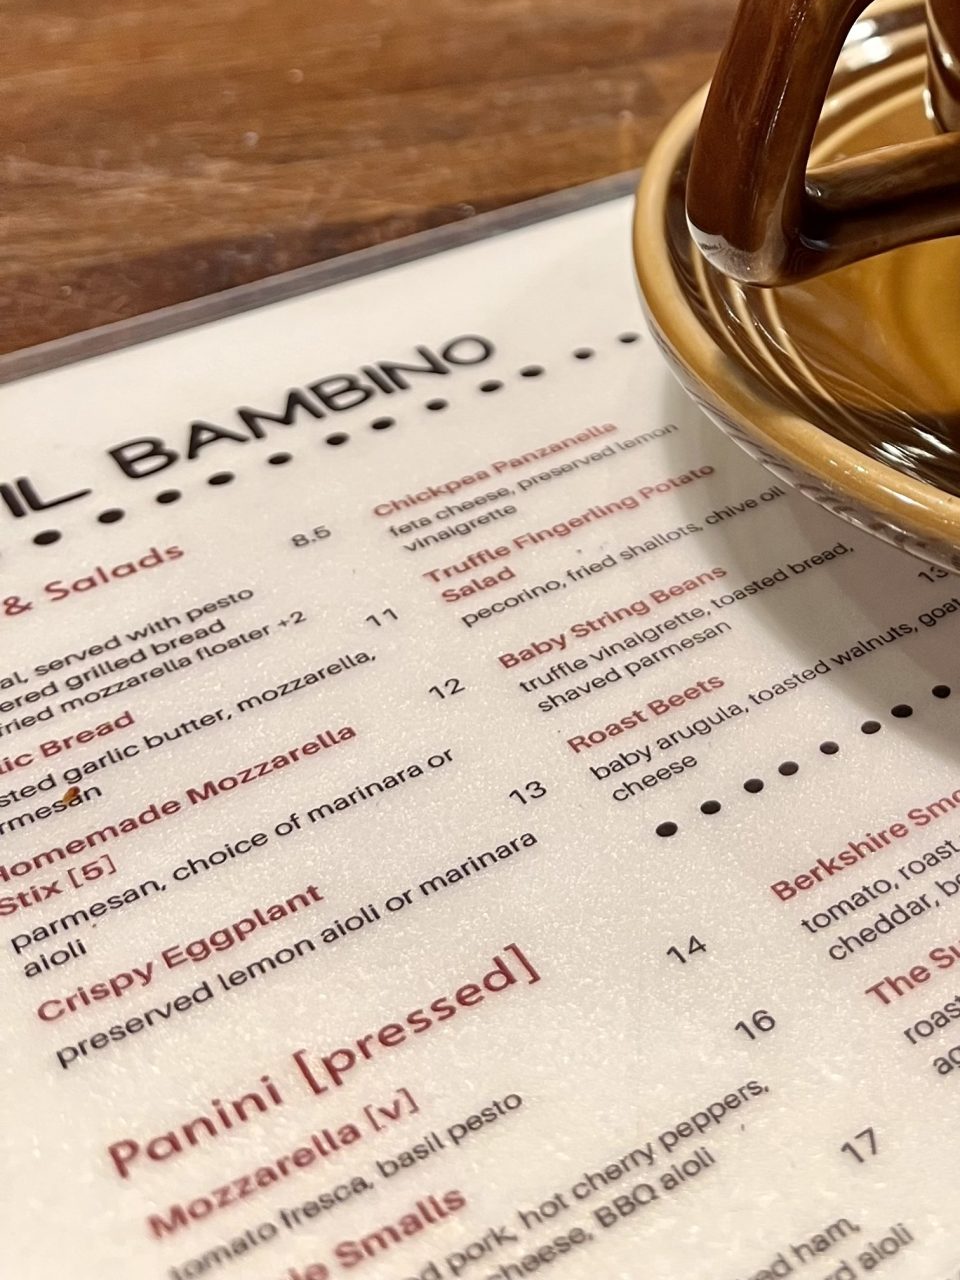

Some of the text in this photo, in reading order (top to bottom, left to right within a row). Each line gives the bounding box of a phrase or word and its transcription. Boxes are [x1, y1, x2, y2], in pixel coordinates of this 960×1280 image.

[0, 334, 496, 519] IL BAMBINO
[373, 421, 618, 518] Chickpea Panzanella
[390, 423, 678, 538] feta cheese, preserved lemon
[291, 526, 331, 548] 8.5
[403, 504, 518, 552] vinaigrette
[422, 464, 715, 584] Truffle Fingerling Potato
[461, 485, 786, 628] pecorino, fried shallots, chive oil
[2, 546, 185, 617] & Salads
[365, 607, 399, 627] 11
[441, 566, 517, 605] Salad
[498, 566, 728, 670] Baby String Beans
[519, 541, 854, 694] truffle vinaigrette, toasted bread,
[34, 588, 254, 675] served with pesto
[61, 624, 270, 713] mozzarella floater
[65, 619, 226, 690] grilled bread
[537, 620, 732, 714] shaved parmesan
[63, 649, 377, 784] garlic butter, mozzarella,
[429, 676, 466, 700] 12
[567, 674, 725, 754] Roast Beets
[589, 744, 651, 781] baby
[656, 702, 749, 752] arugula,
[748, 660, 833, 705] toasted
[831, 621, 918, 667] walnuts,
[40, 711, 135, 758] Bread
[186, 726, 357, 808] Mozzarella
[509, 780, 547, 806] 13
[612, 754, 698, 802] cheese
[0, 854, 117, 916] Stix [5]
[11, 748, 453, 954] parmesan, choice of marinara or
[770, 821, 909, 902] Berkshire
[801, 877, 900, 934] tomato,
[898, 839, 960, 881] roast
[24, 939, 87, 979] aioli
[37, 885, 325, 1022] Crispy Eggplant
[56, 832, 538, 1070] preserved lemon aioli or marinara
[666, 935, 707, 963] 14
[828, 893, 940, 961] cheddar,
[735, 1009, 776, 1040] 16
[865, 963, 931, 1006] The
[108, 942, 541, 1180] Panini [pressed]
[147, 1086, 420, 1238] Mozzarella [v]
[376, 1093, 522, 1178] basil pesto
[518, 1081, 770, 1229] hot cherry peppers,
[841, 1127, 878, 1163] 17
[592, 1147, 716, 1228] BBQ aioli
[334, 1189, 466, 1268] Smalls
